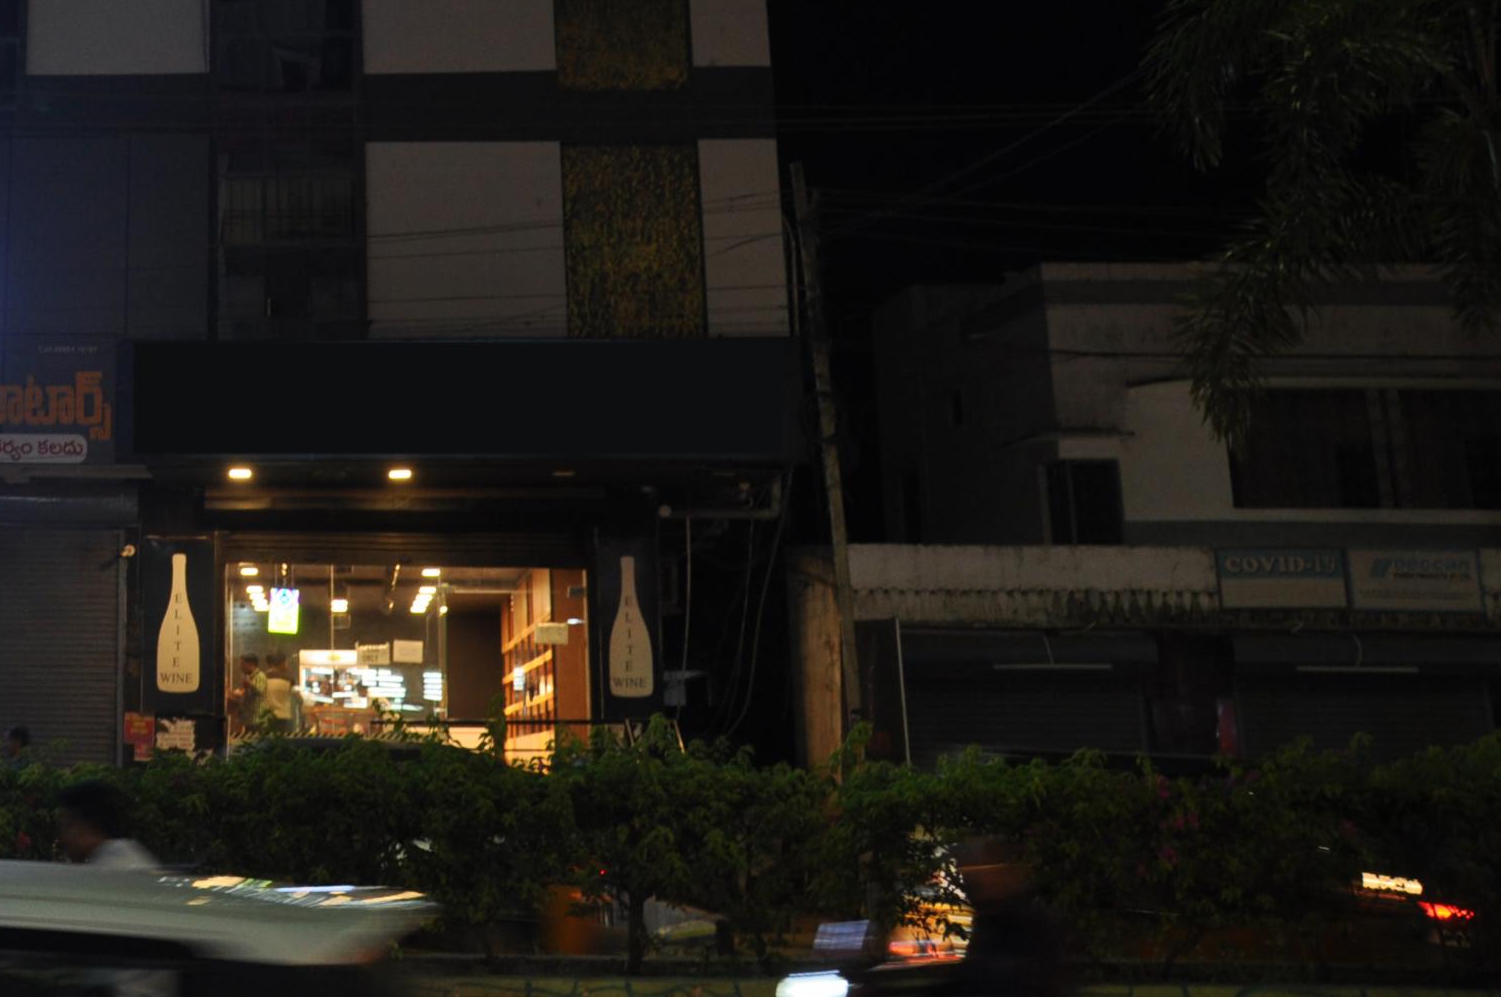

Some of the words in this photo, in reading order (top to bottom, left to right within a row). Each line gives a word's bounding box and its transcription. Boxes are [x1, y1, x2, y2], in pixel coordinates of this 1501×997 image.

[37, 440, 84, 455] కలదు
[160, 672, 193, 684] WINE
[612, 677, 647, 689] WINE
